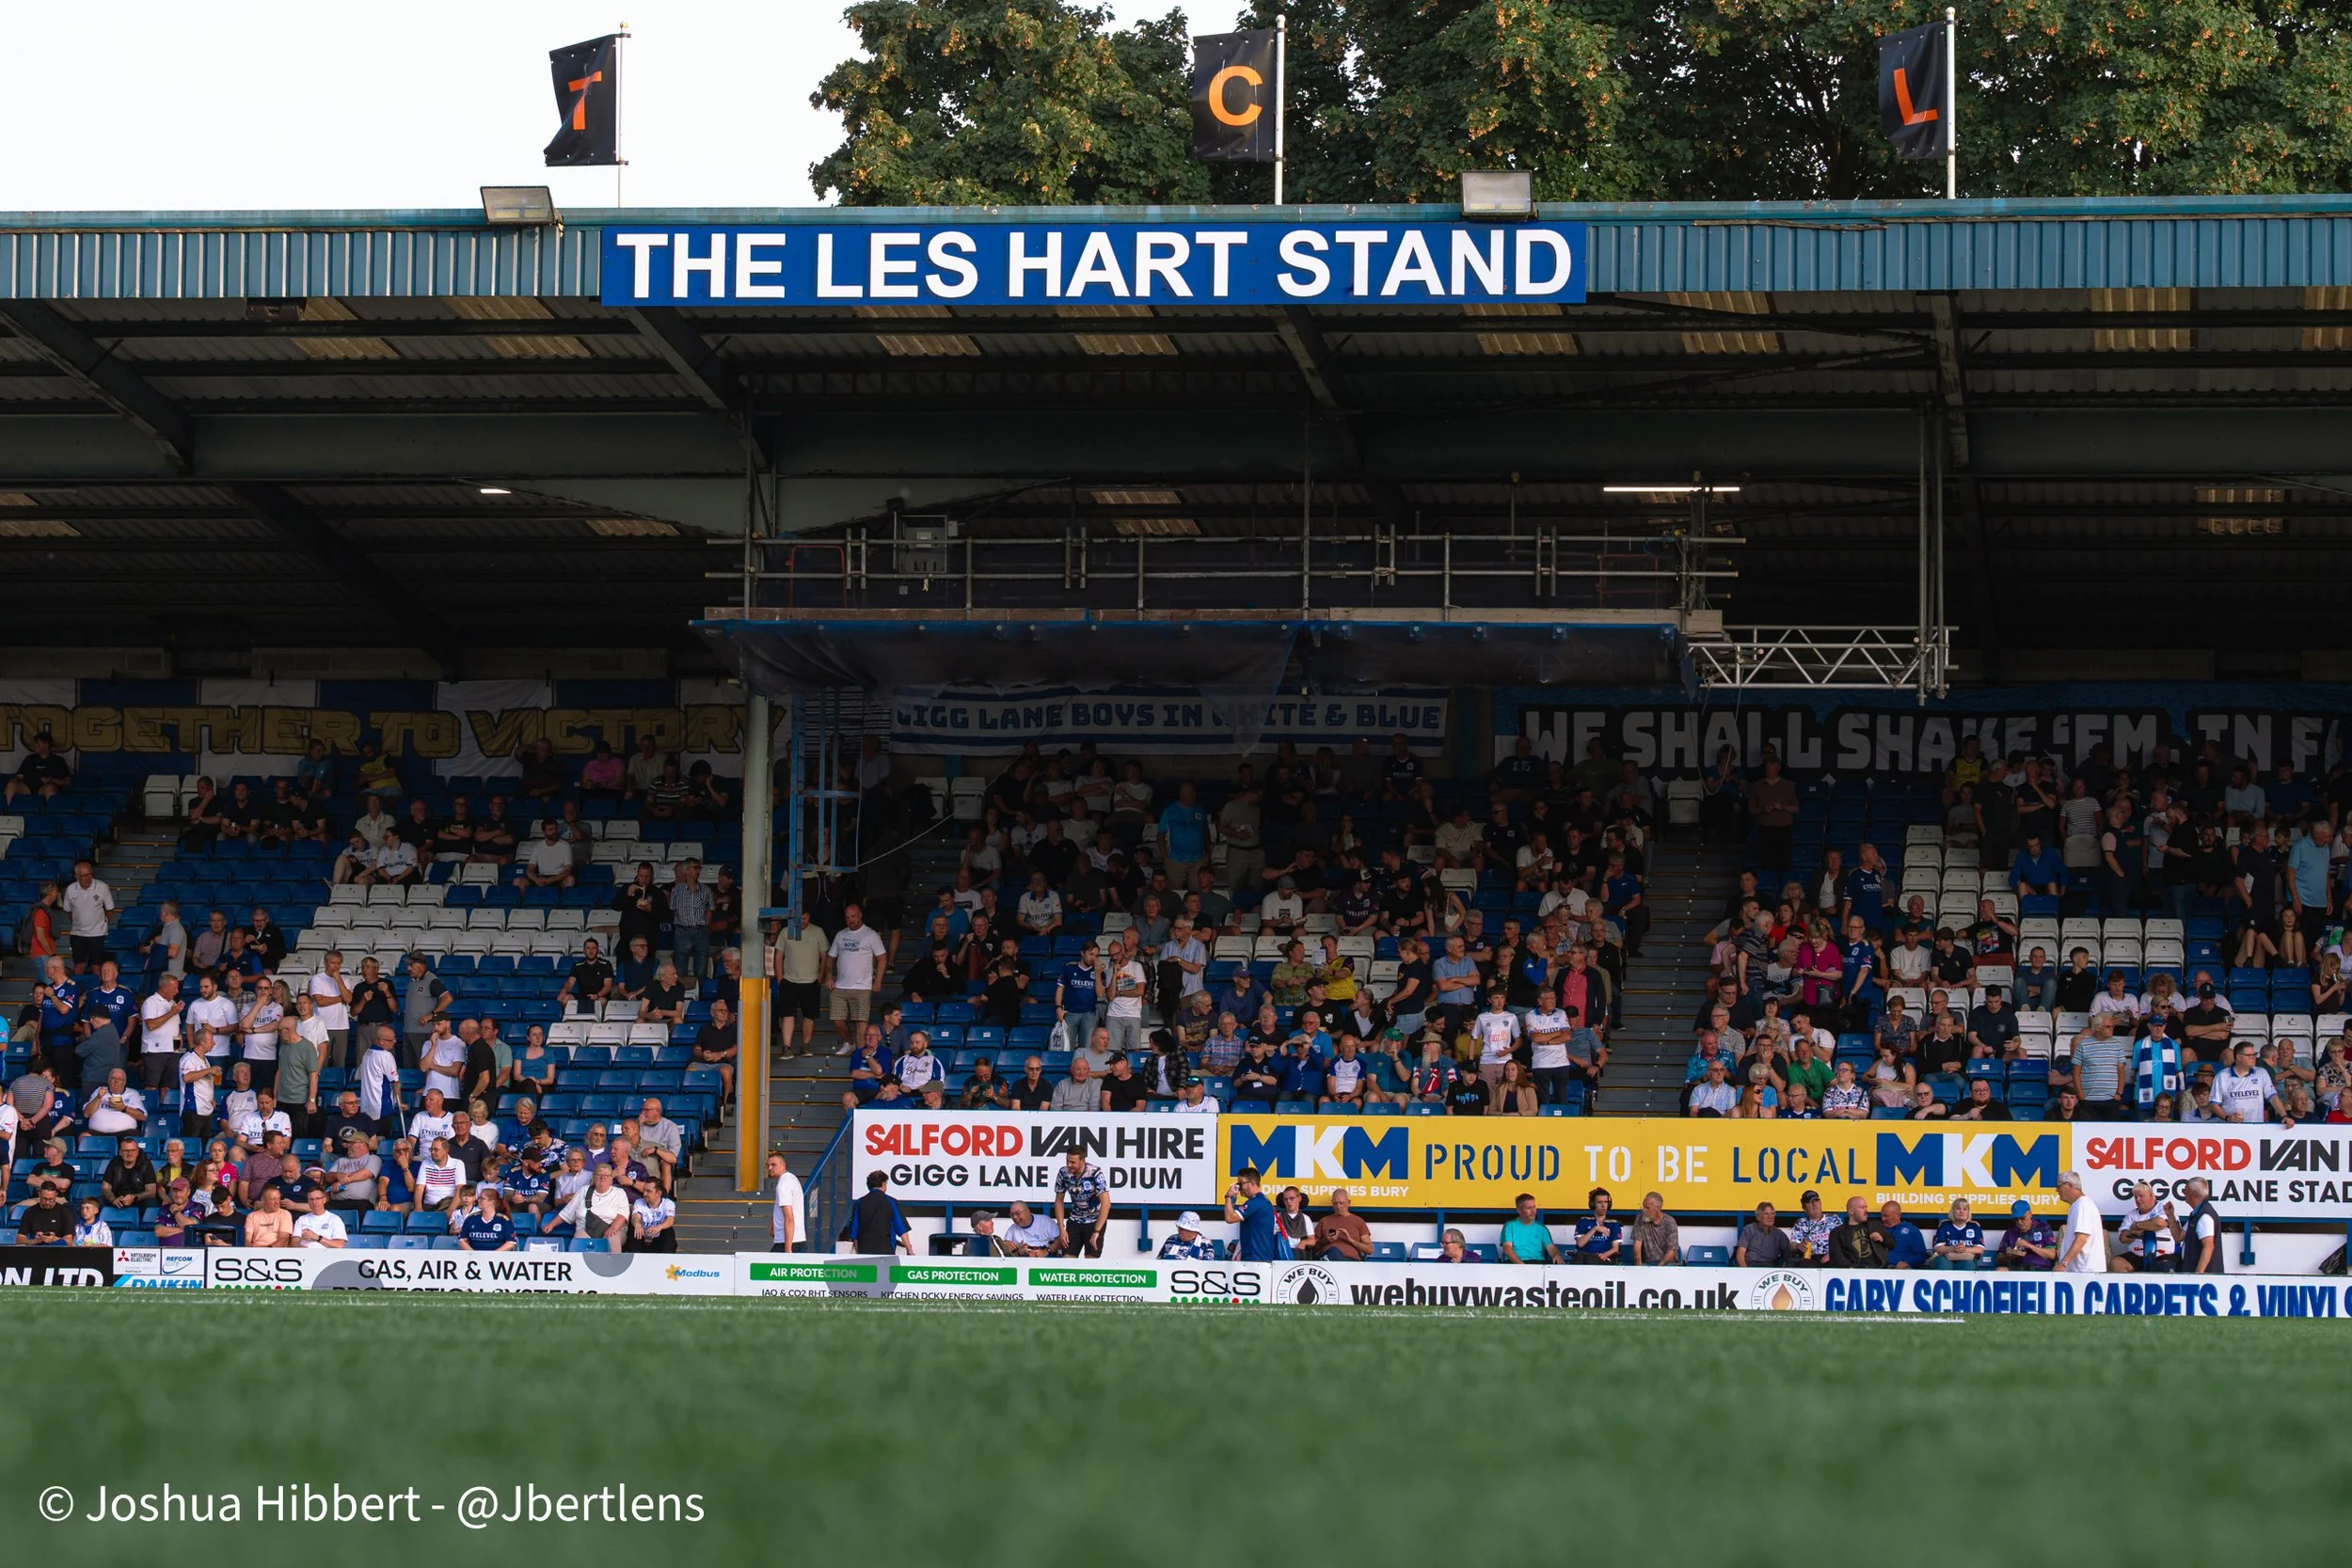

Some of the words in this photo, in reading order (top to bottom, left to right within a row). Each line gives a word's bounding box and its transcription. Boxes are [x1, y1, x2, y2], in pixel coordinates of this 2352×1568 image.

[568, 71, 602, 130] T
[1208, 65, 1263, 126] C
[1893, 68, 1938, 126] L
[617, 233, 786, 298] THE
[817, 231, 978, 299] LES
[1009, 231, 1248, 297] HART
[1277, 229, 1571, 297] STAND
[979, 704, 1063, 730] LANE
[1072, 703, 1154, 727] BOYS
[1164, 704, 1202, 727] IN
[1325, 705, 1347, 726] &
[1357, 705, 1439, 729] BLUE
[465, 705, 745, 758] VICTOR
[866, 1124, 1023, 1157] SALFORD
[1031, 1126, 1105, 1158] VAN
[1116, 1128, 1203, 1159] HIRE
[1230, 1125, 1409, 1180] MKM
[1425, 1144, 1560, 1181] PROUD
[1584, 1146, 1631, 1182] TO
[1658, 1146, 1708, 1182] BE
[1733, 1147, 1867, 1184] LOCAL
[1876, 1132, 2059, 1188] MKM
[2086, 1137, 2251, 1171] SALFORD
[2260, 1139, 2339, 1172] VAN
[890, 1164, 969, 1186] GIGG
[979, 1165, 1048, 1187] LANE
[1371, 1185, 1409, 1197] BURY
[1876, 1193, 1944, 1204] BUILDING
[2021, 1195, 2060, 1205] BURY
[2206, 1180, 2278, 1202] LANE
[215, 1258, 303, 1282] S&S
[358, 1259, 412, 1283] GAS,
[419, 1259, 457, 1280] AIR
[464, 1260, 481, 1280] &
[489, 1260, 572, 1281] WATER
[675, 1269, 721, 1278] Modbus
[770, 1267, 787, 1277] AIR
[790, 1268, 857, 1278] PROTECTION
[907, 1270, 930, 1280] GAS
[931, 1271, 999, 1281] PROTECTION
[1040, 1272, 1077, 1283] WATER
[1079, 1273, 1147, 1284] PROTECTION
[1284, 1268, 1305, 1284] WE
[1309, 1268, 1334, 1286] BUY
[788, 1290, 806, 1298] CO2
[808, 1290, 826, 1298] RHT
[828, 1290, 868, 1298] SENSORS
[1170, 1270, 1262, 1295] S&S
[1758, 1275, 1779, 1290] WE
[1783, 1274, 1808, 1291] BUY
[881, 1291, 919, 1299] KITCHEN
[986, 1292, 1024, 1301] SAVINGS
[1037, 1293, 1068, 1302] WATER
[1070, 1293, 1092, 1302] LEAK
[1093, 1294, 1144, 1303] DETECTION
[2227, 1284, 2251, 1317] &
